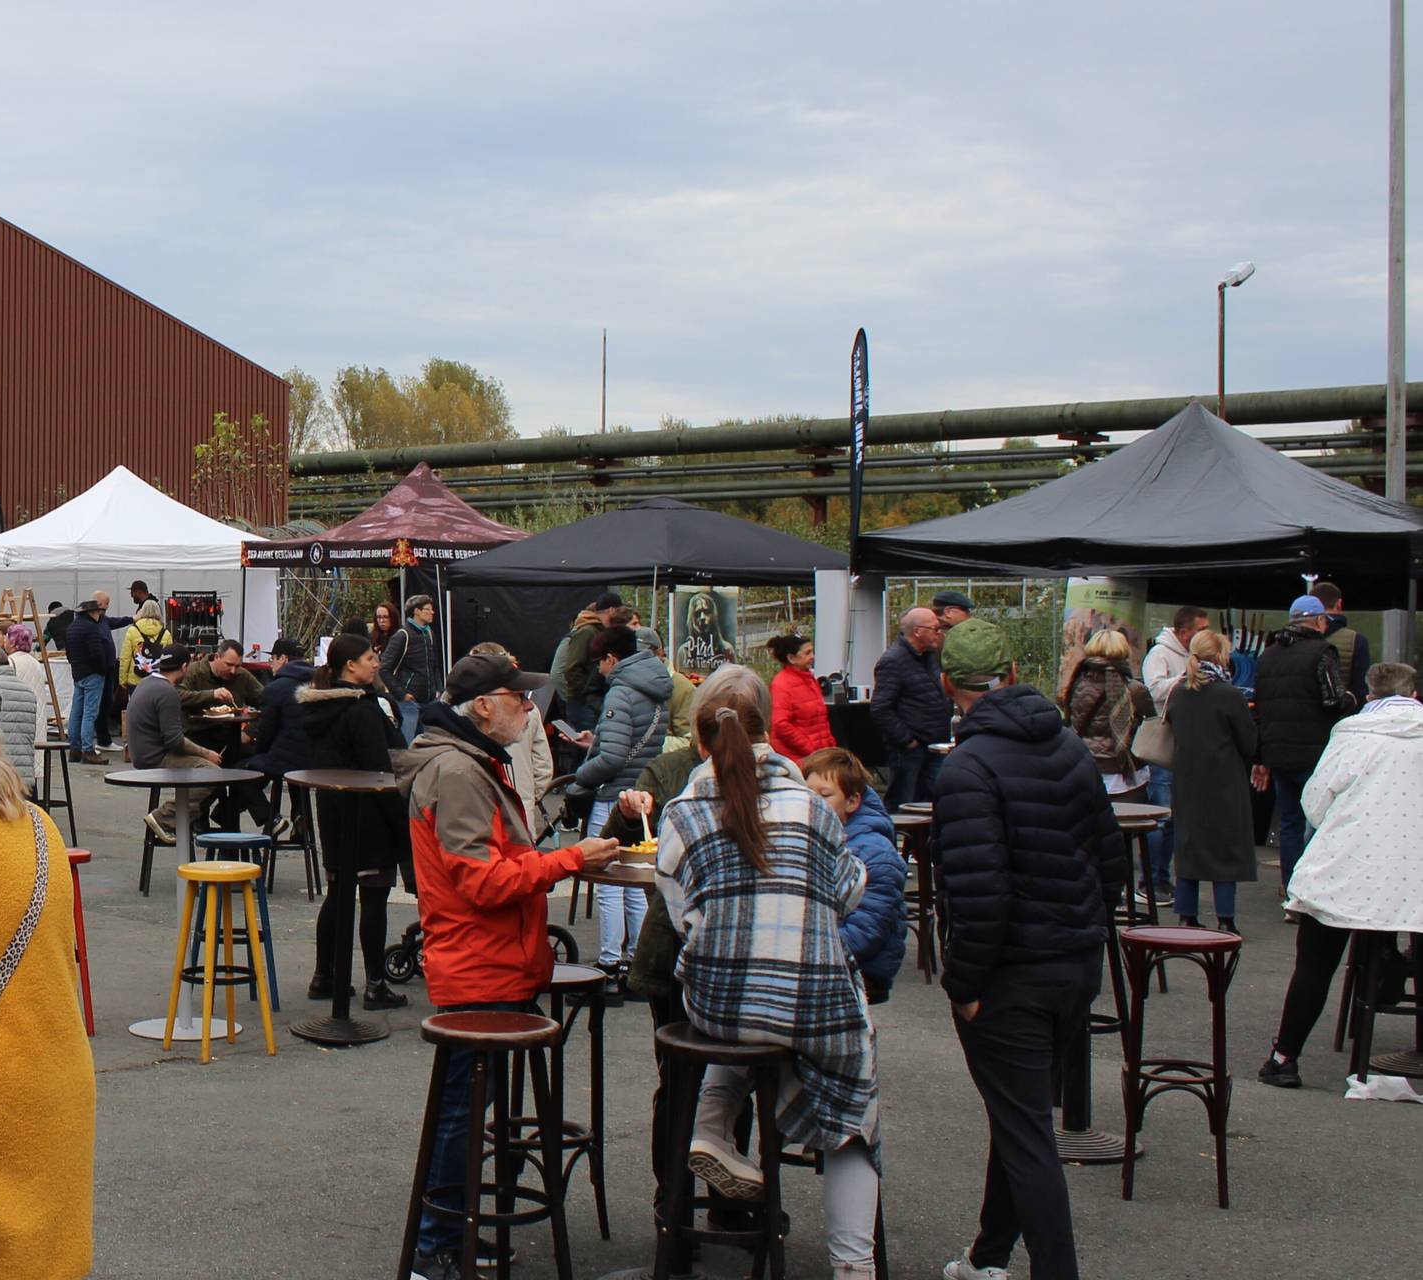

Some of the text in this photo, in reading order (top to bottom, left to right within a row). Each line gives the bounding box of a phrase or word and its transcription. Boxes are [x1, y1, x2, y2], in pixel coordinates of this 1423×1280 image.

[413, 548, 428, 558] DER
[429, 549, 454, 559] KLEINE
[685, 634, 715, 658] Pfad
